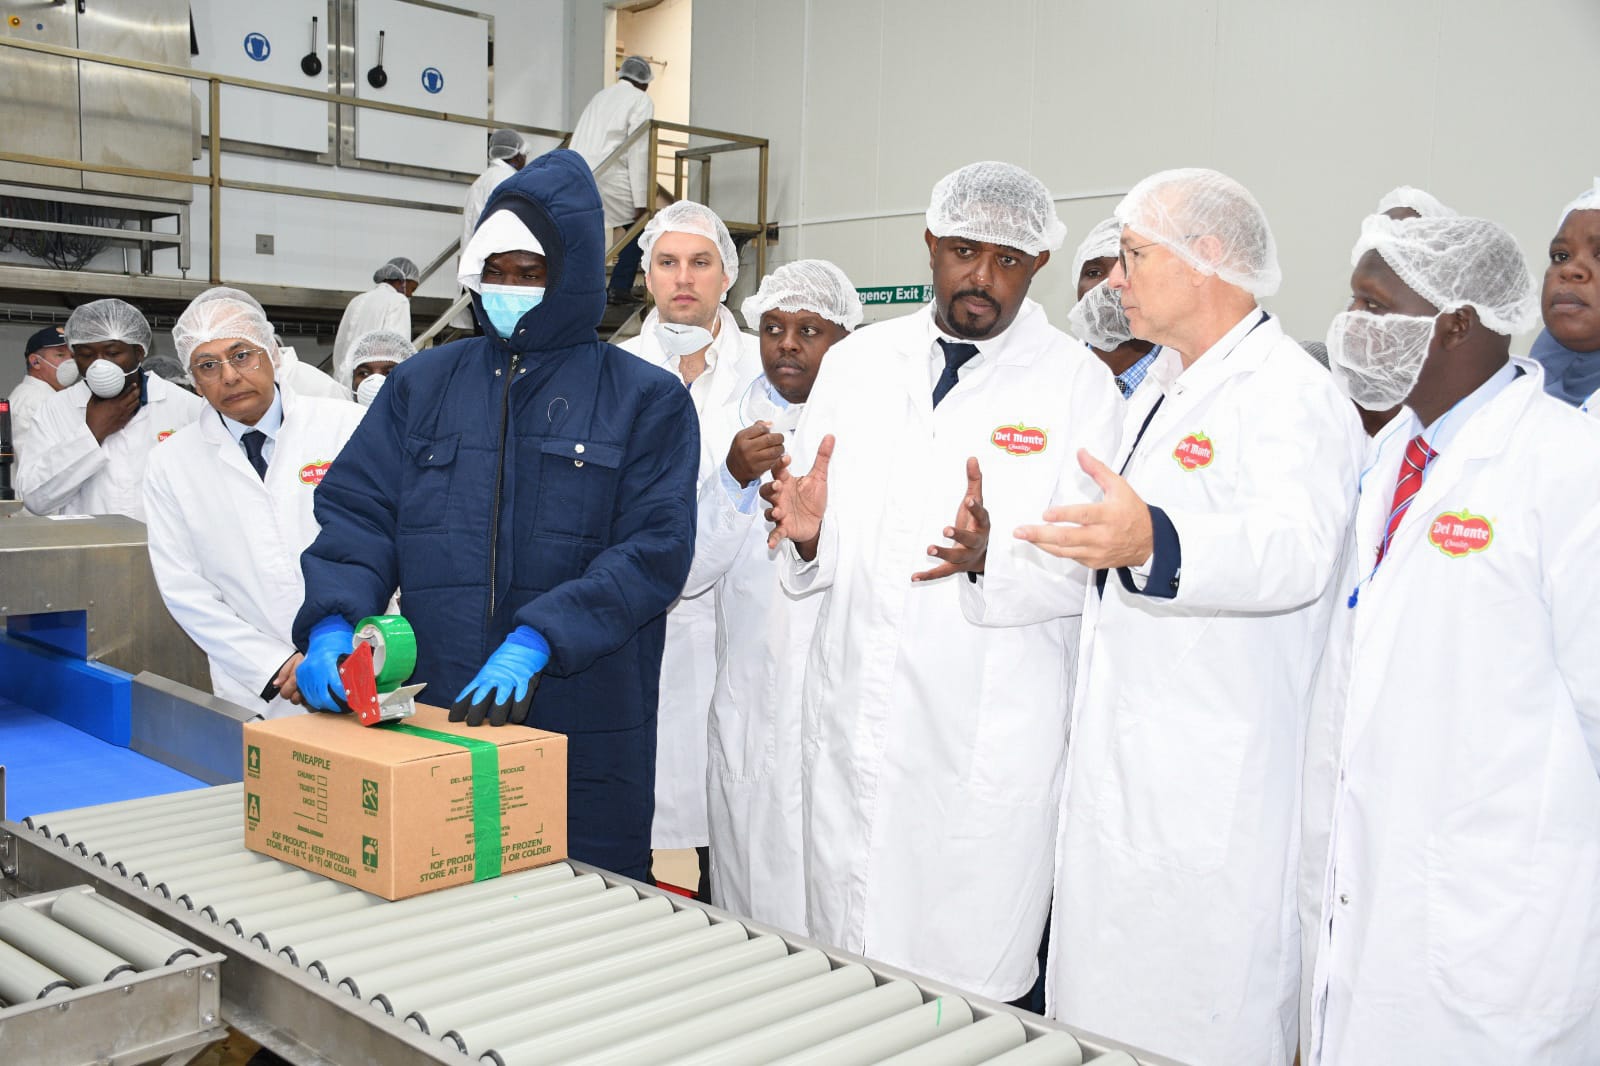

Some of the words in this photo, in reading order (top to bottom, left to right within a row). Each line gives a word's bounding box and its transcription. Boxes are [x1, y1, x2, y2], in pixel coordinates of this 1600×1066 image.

[858, 290, 893, 304] gency
[896, 287, 919, 300] Exit
[995, 431, 1011, 442] Del
[1013, 433, 1044, 446] Monte
[1433, 522, 1450, 535] Del
[1452, 523, 1488, 541] Monte
[292, 750, 331, 771] PINEAPPLE
[500, 765, 525, 775] PRODUCE
[266, 838, 283, 851] STORE
[283, 845, 291, 854] AT
[324, 860, 333, 869] OR
[333, 862, 357, 878] COLDER
[282, 834, 308, 850] PRODUCT
[311, 844, 326, 856] KEEP
[327, 850, 350, 865] FROZEN
[446, 853, 476, 867] PRODU
[512, 838, 543, 851] FROZEN
[420, 869, 446, 882] STORE
[447, 866, 459, 876] AT
[508, 852, 520, 862] OR
[521, 845, 552, 858] COLDER
